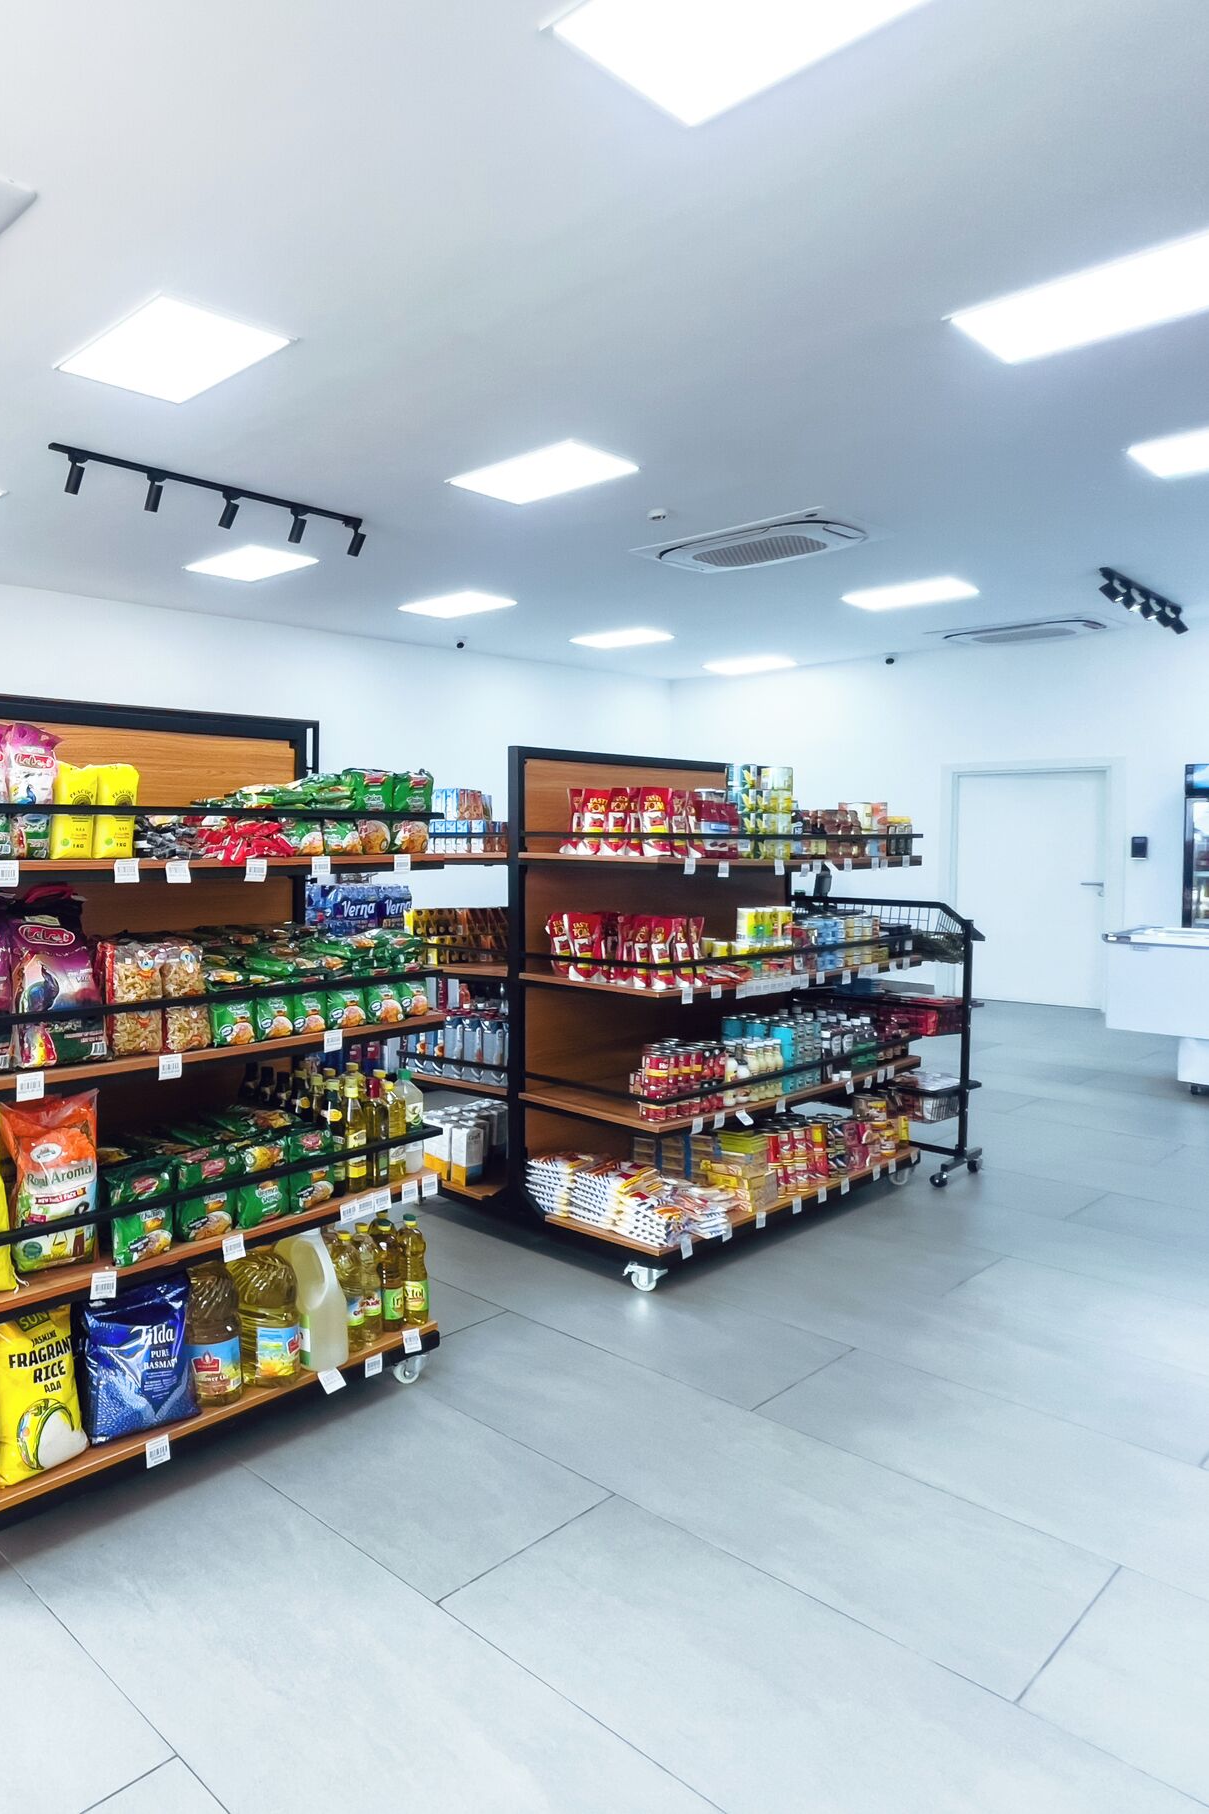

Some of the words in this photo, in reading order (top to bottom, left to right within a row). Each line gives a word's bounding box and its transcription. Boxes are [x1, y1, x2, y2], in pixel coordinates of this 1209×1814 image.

[342, 900, 375, 918] Verna
[385, 899, 412, 915] Verna
[51, 1165, 92, 1184] Aroma
[19, 1311, 50, 1329] SUN
[31, 1330, 57, 1347] JASMINE
[130, 1323, 175, 1345] Tilda
[8, 1335, 72, 1369] FRAGRANT
[150, 1348, 170, 1358] PURE
[33, 1360, 66, 1384] RICE
[44, 1380, 62, 1394] AAA
